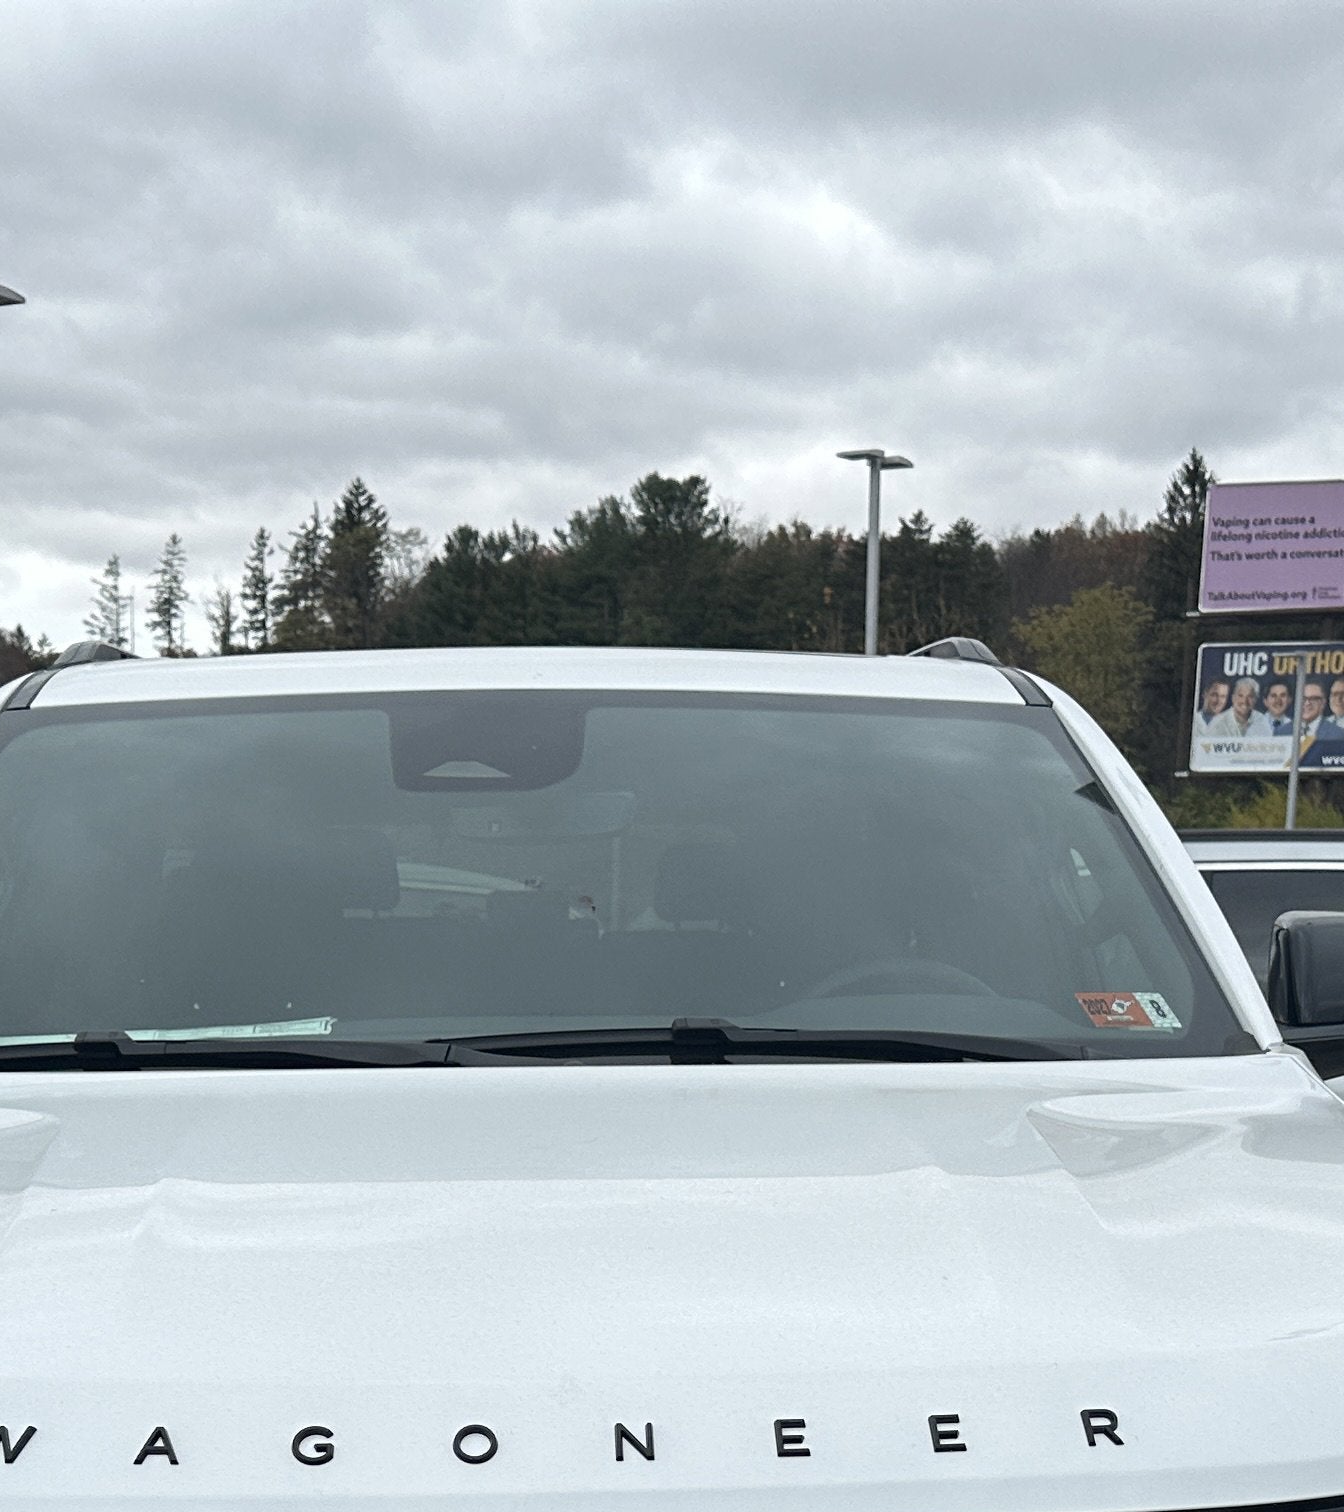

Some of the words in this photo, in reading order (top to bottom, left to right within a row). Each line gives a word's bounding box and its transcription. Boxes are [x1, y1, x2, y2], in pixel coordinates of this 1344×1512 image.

[1212, 516, 1250, 528] Vaping
[1252, 518, 1272, 526] can
[1274, 517, 1306, 526] cause
[1308, 515, 1316, 525] a
[1210, 531, 1253, 543] lifelong
[1255, 529, 1300, 541] nicotine
[1210, 551, 1243, 562] That's
[1245, 548, 1279, 560] worth
[1280, 552, 1288, 560] a
[1223, 651, 1268, 677] UHC
